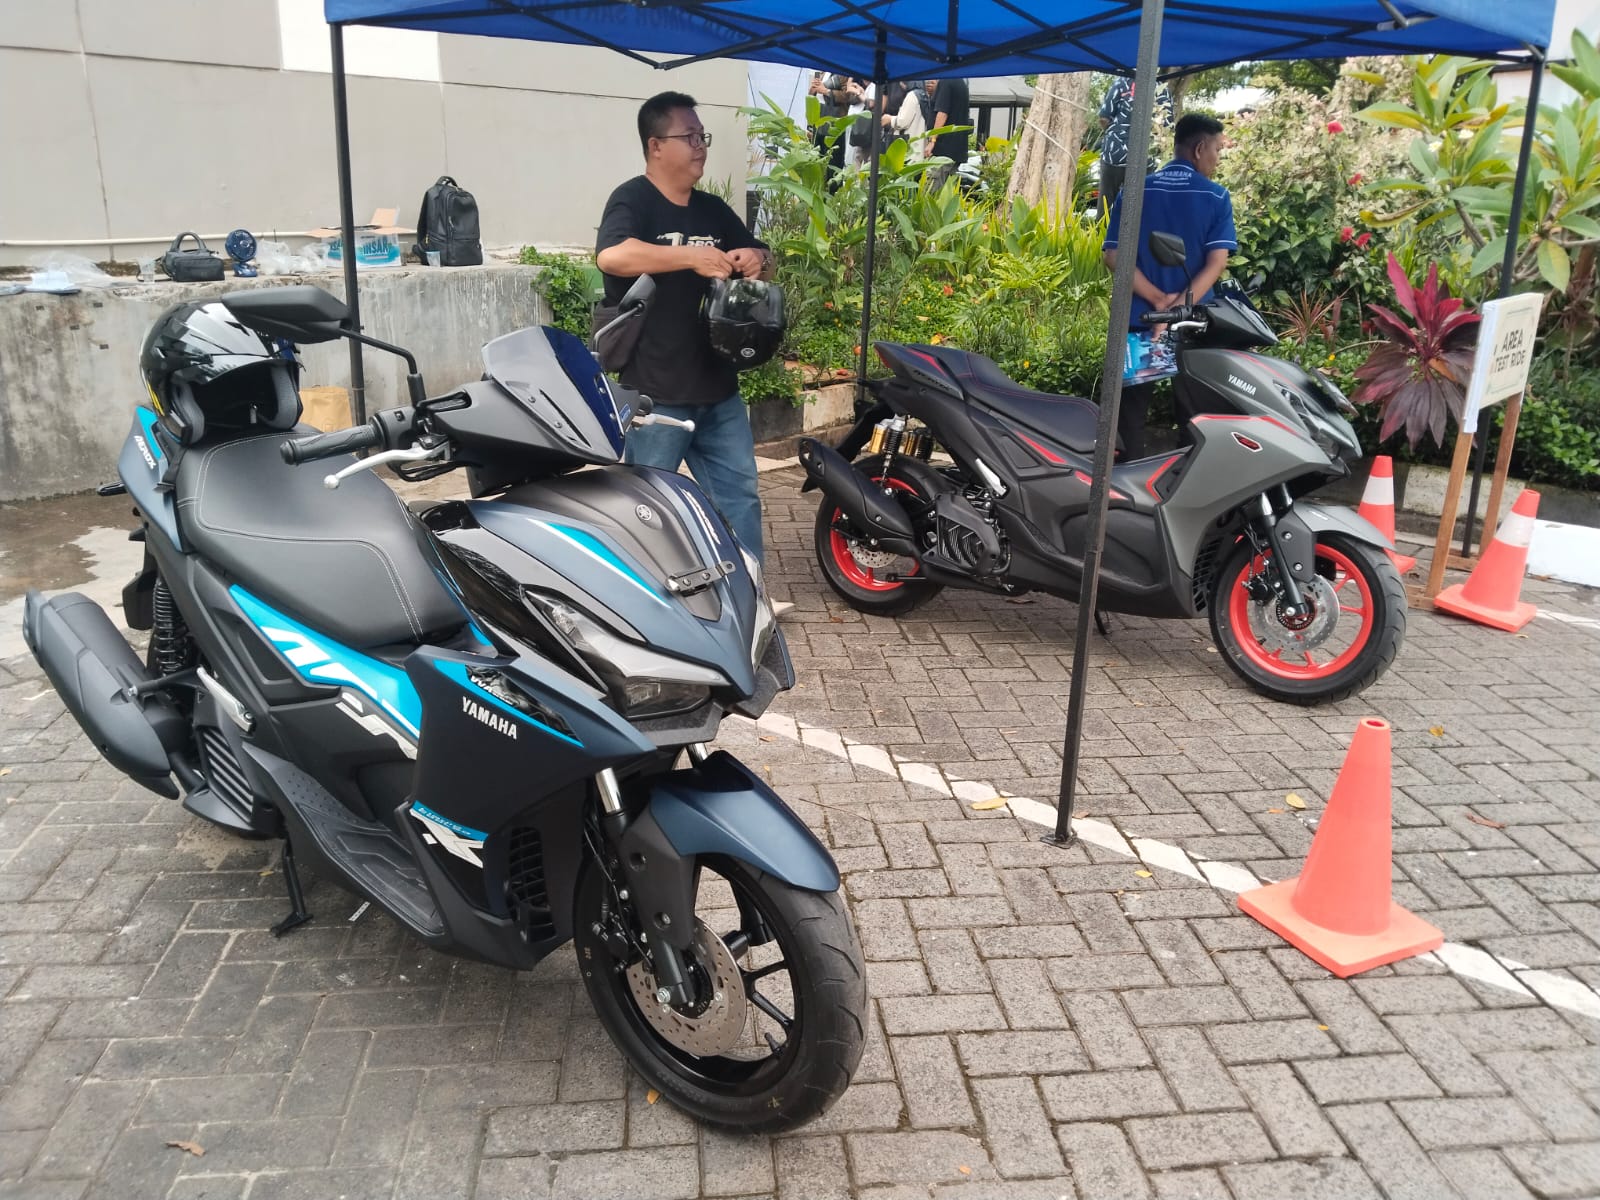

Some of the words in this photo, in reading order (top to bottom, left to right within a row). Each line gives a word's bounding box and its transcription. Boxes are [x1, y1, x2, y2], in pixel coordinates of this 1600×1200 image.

[1501, 328, 1524, 353] AREA
[1494, 353, 1510, 373] TEST
[1510, 349, 1526, 368] RIDE
[1228, 373, 1257, 396] YAMAHA
[133, 435, 157, 470] AEROX
[462, 695, 518, 740] YAMAHA
